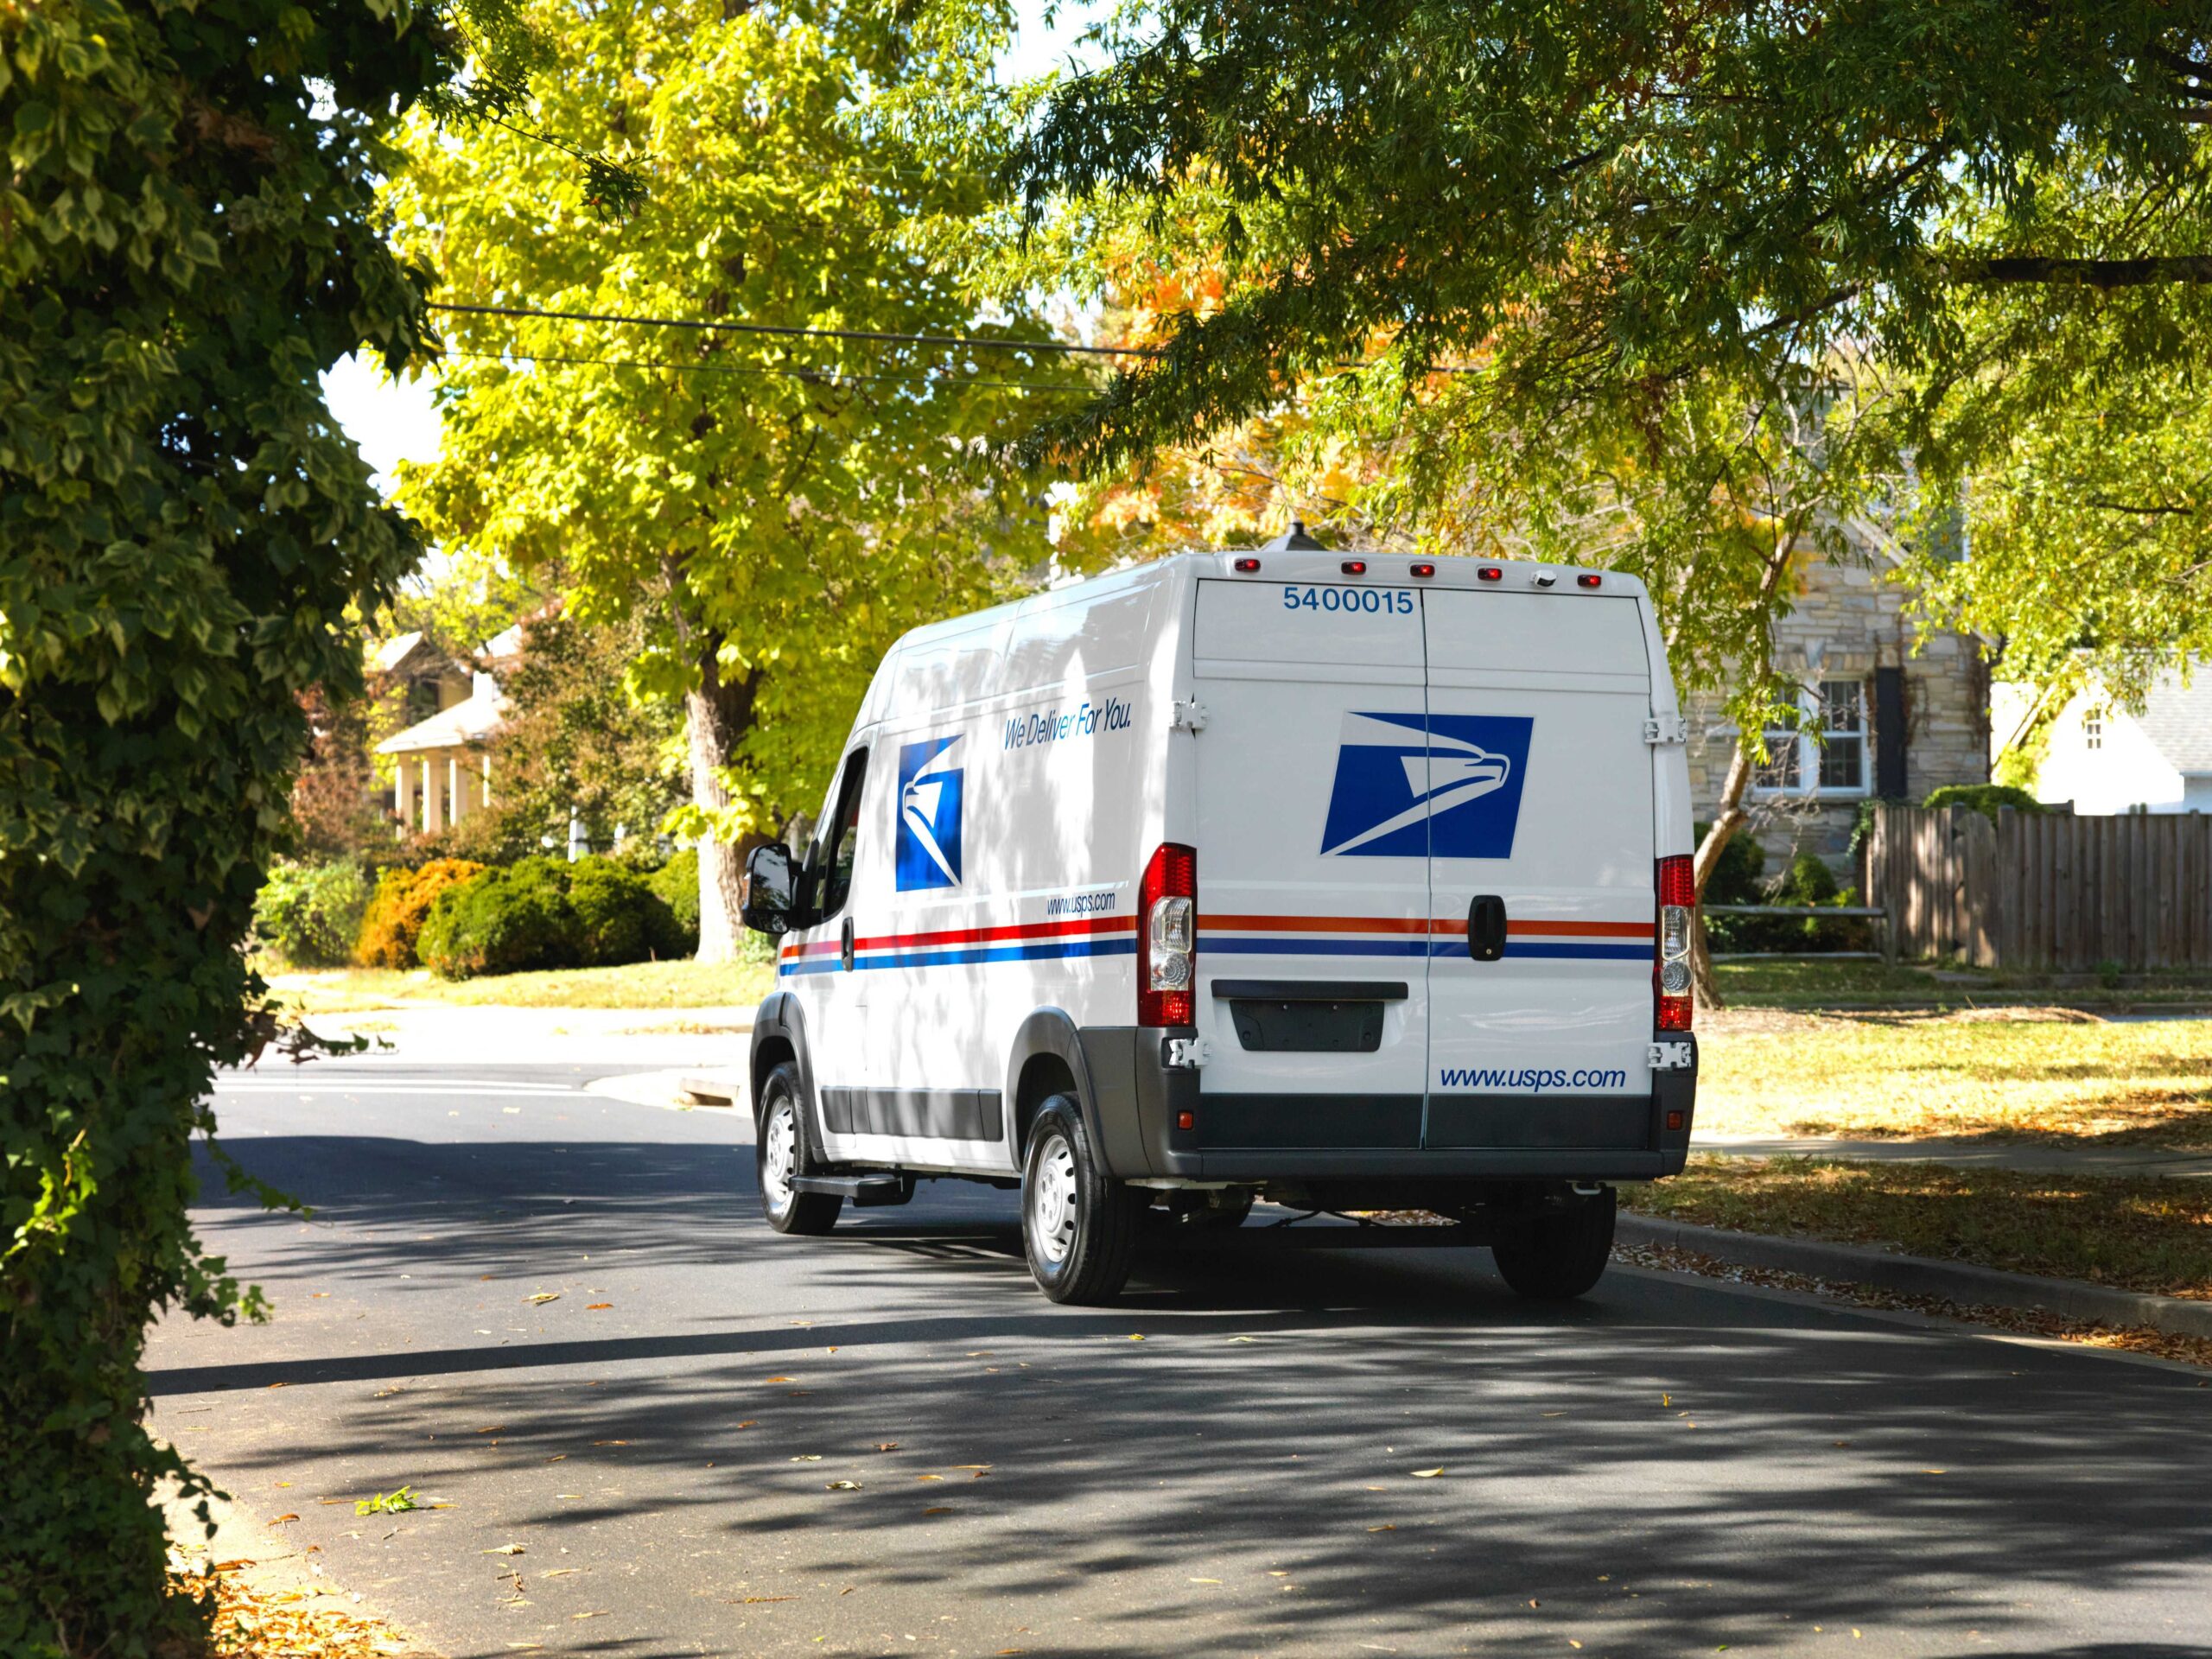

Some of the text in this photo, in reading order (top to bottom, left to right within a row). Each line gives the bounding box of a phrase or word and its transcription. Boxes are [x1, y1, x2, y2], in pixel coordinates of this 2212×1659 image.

[1283, 587, 1414, 614] 5400015
[1004, 696, 1131, 750] We Deliver For You.
[1047, 892, 1116, 918] www.usps.com
[1440, 1069, 1626, 1093] www.usps.com
